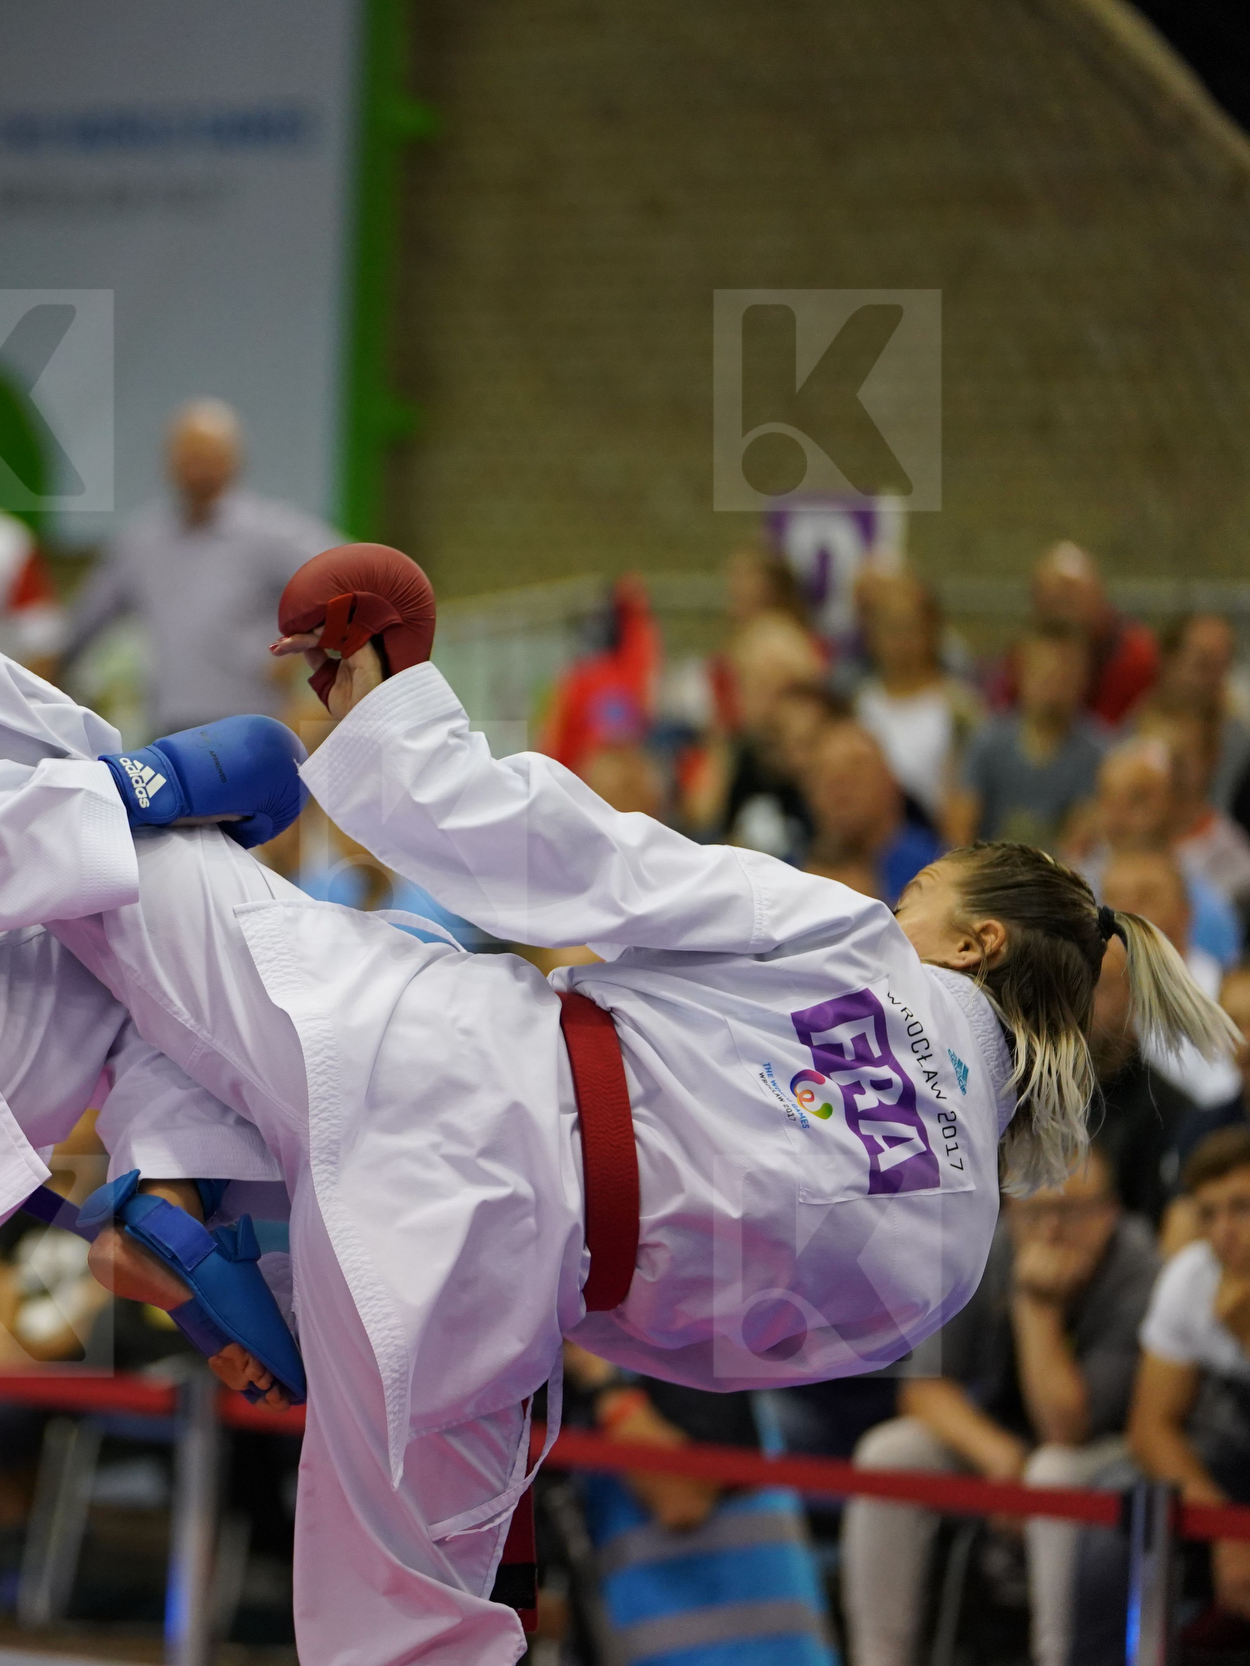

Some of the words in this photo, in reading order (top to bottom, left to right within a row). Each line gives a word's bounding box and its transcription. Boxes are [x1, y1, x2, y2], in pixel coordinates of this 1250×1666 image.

[119, 757, 150, 809] adidas
[209, 750, 228, 784] APPROVED
[763, 1062, 775, 1078] THE
[791, 1103, 810, 1129] GAMES
[810, 1014, 927, 1173] FRA
[937, 1110, 964, 1171] 2017
